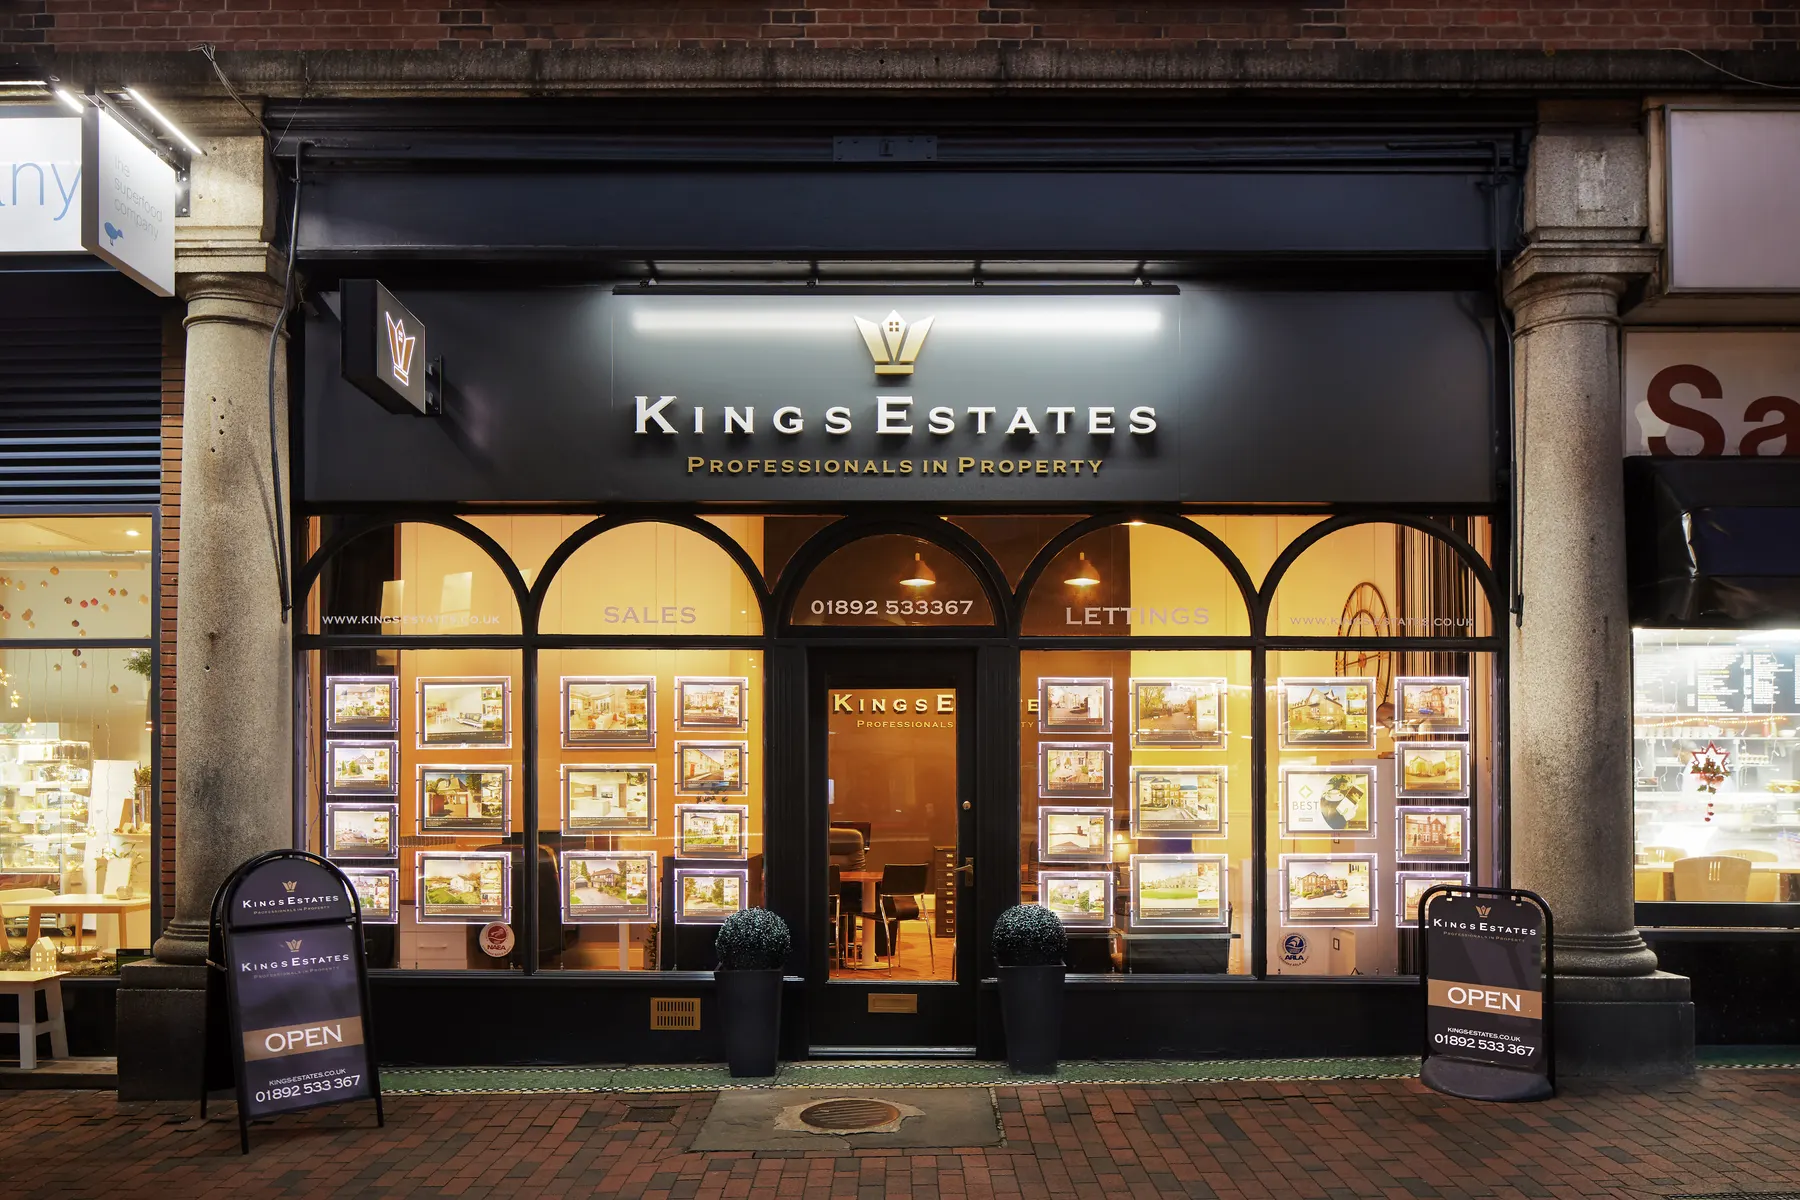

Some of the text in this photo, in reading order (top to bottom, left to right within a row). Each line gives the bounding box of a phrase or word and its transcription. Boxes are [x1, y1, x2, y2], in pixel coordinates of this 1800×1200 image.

[0, 162, 81, 220] ny
[114, 177, 163, 222] superfood
[114, 198, 160, 241] company
[687, 456, 1104, 475] PROFESSIONALS IN PROPERTY
[604, 606, 697, 624] SALES
[811, 600, 974, 615] 01892 533367
[1066, 607, 1209, 625] LETTINGS
[857, 720, 954, 728] PROFESSIONALS
[1292, 801, 1319, 810] BEST
[1447, 986, 1521, 1012] OPEN
[264, 1024, 343, 1052] OPEN
[1434, 1033, 1535, 1057] 01892 533 367
[255, 1074, 360, 1102] 01892 533 367
